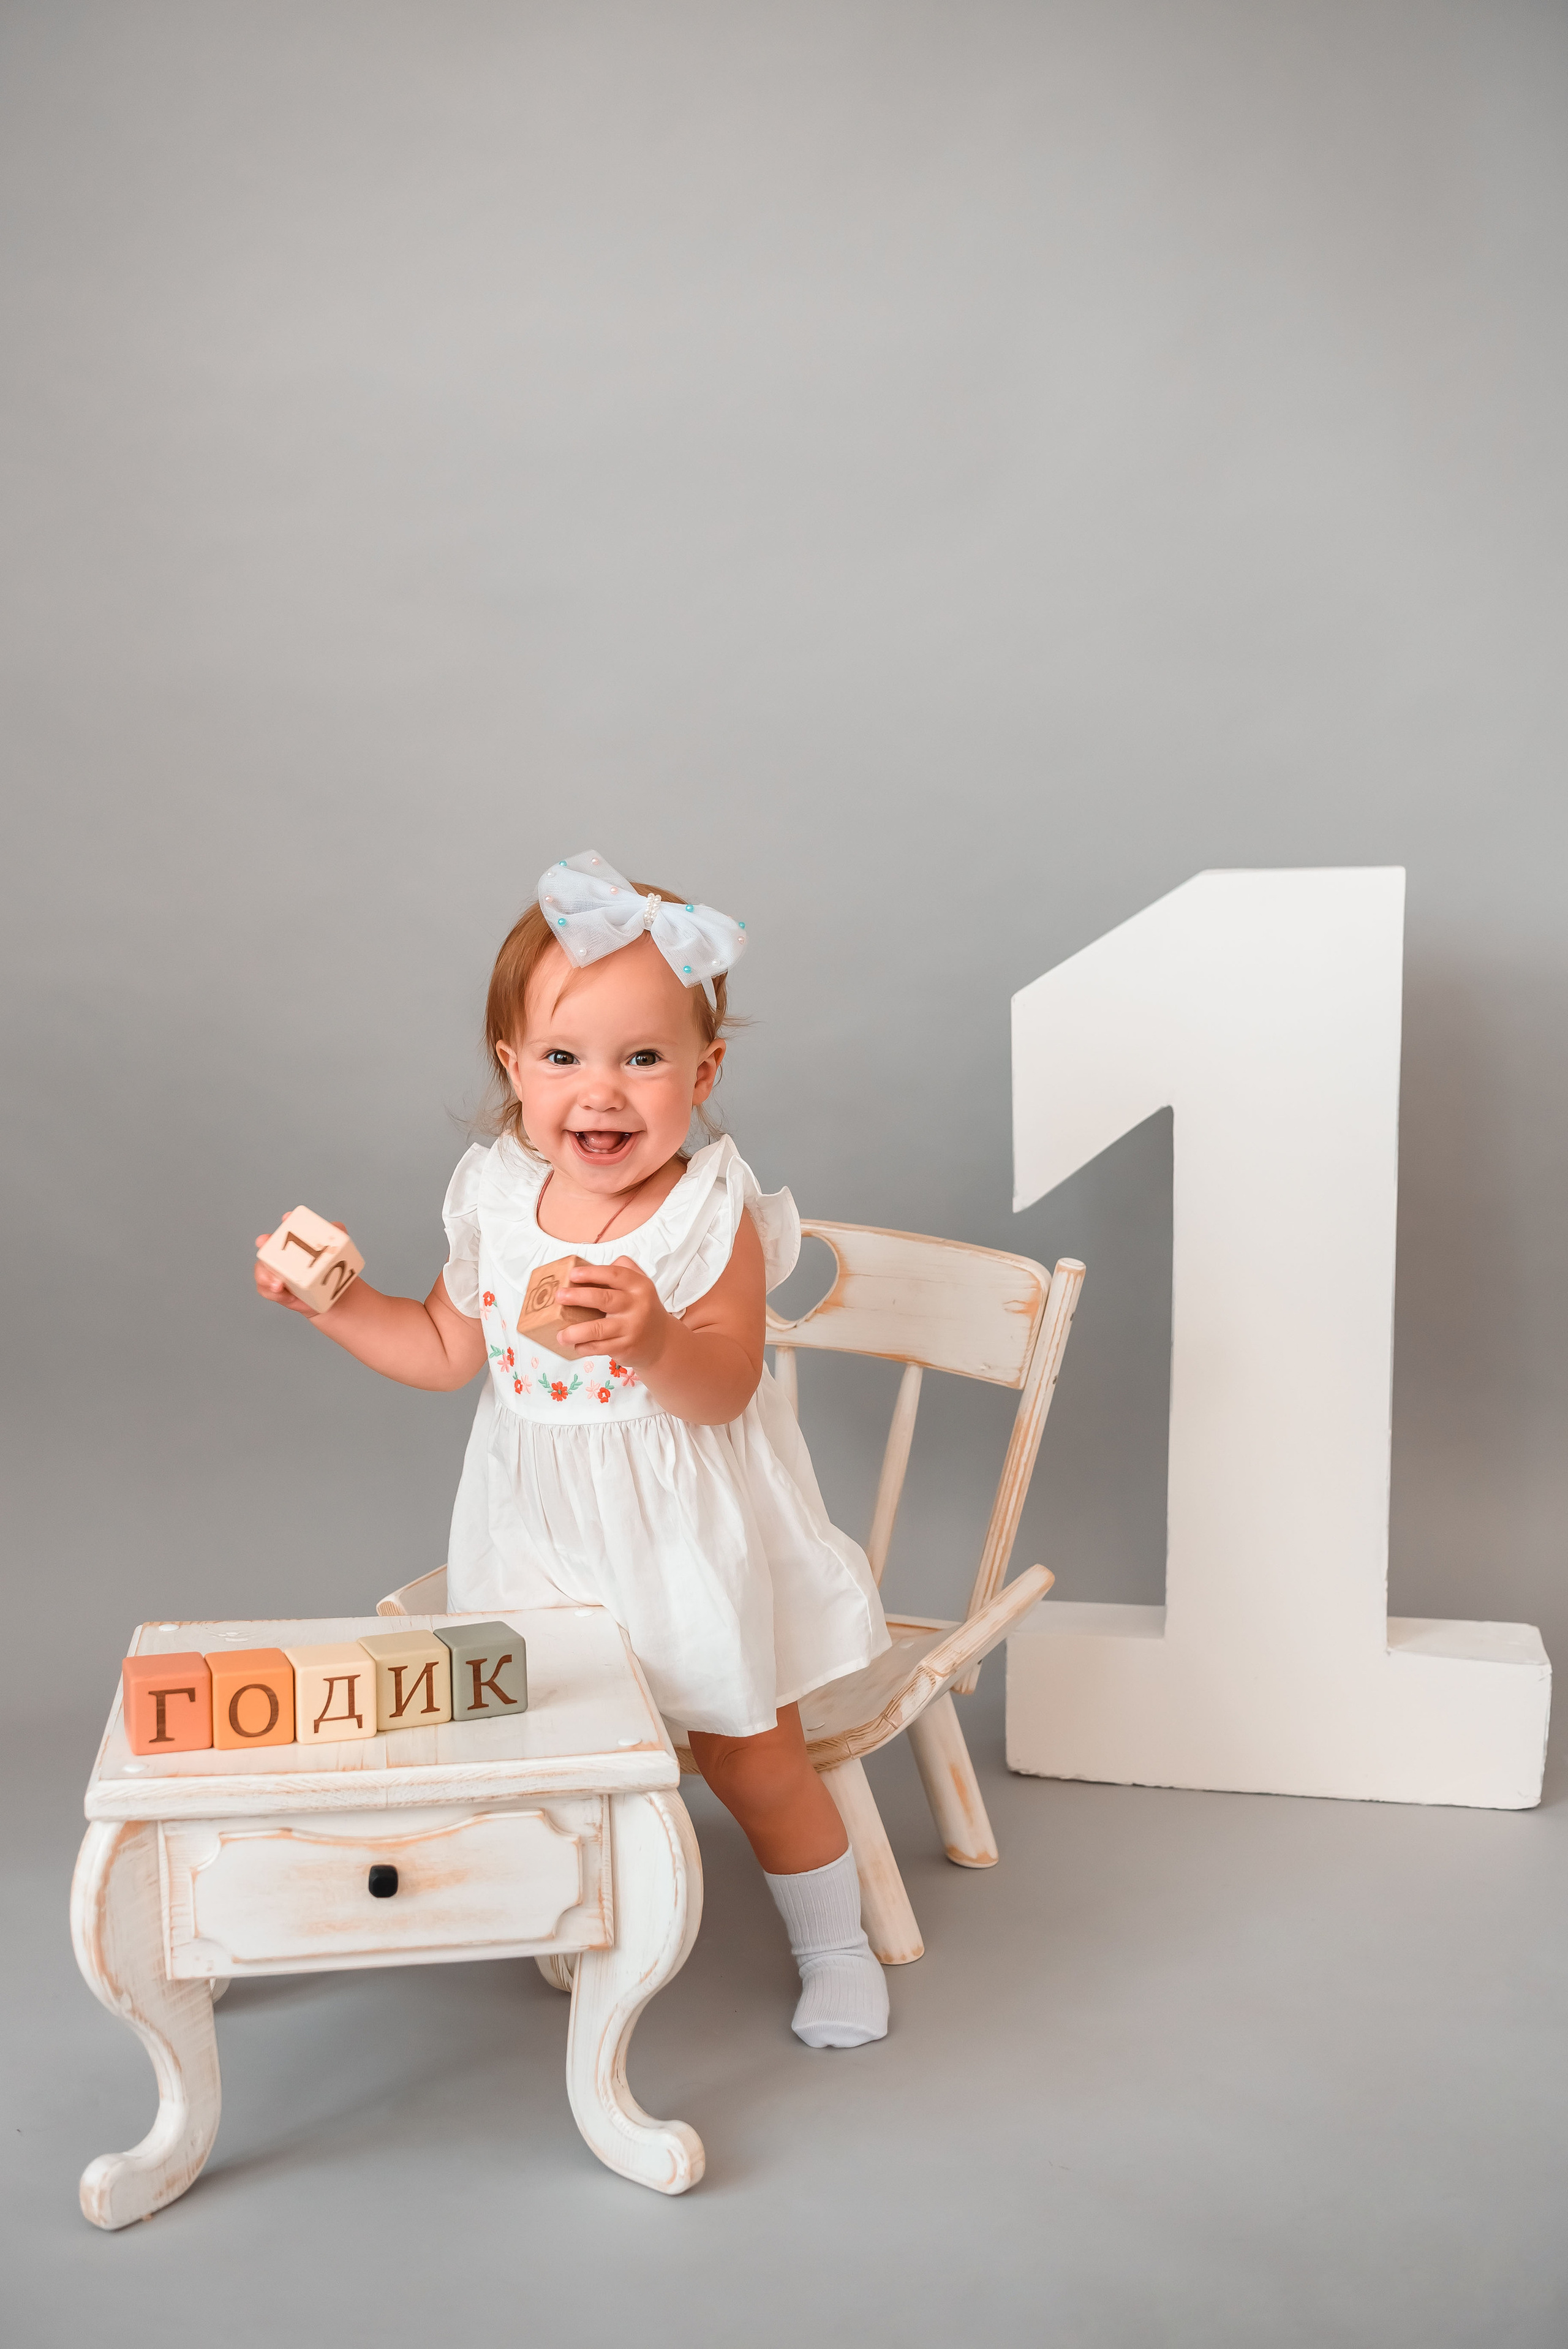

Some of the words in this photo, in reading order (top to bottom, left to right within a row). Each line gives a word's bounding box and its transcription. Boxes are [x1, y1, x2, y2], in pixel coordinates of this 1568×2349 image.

[282, 1231, 329, 1267] 1
[322, 1260, 356, 1300] 2
[1006, 864, 1551, 1810] 1
[148, 1654, 518, 1742] ГОДИК
